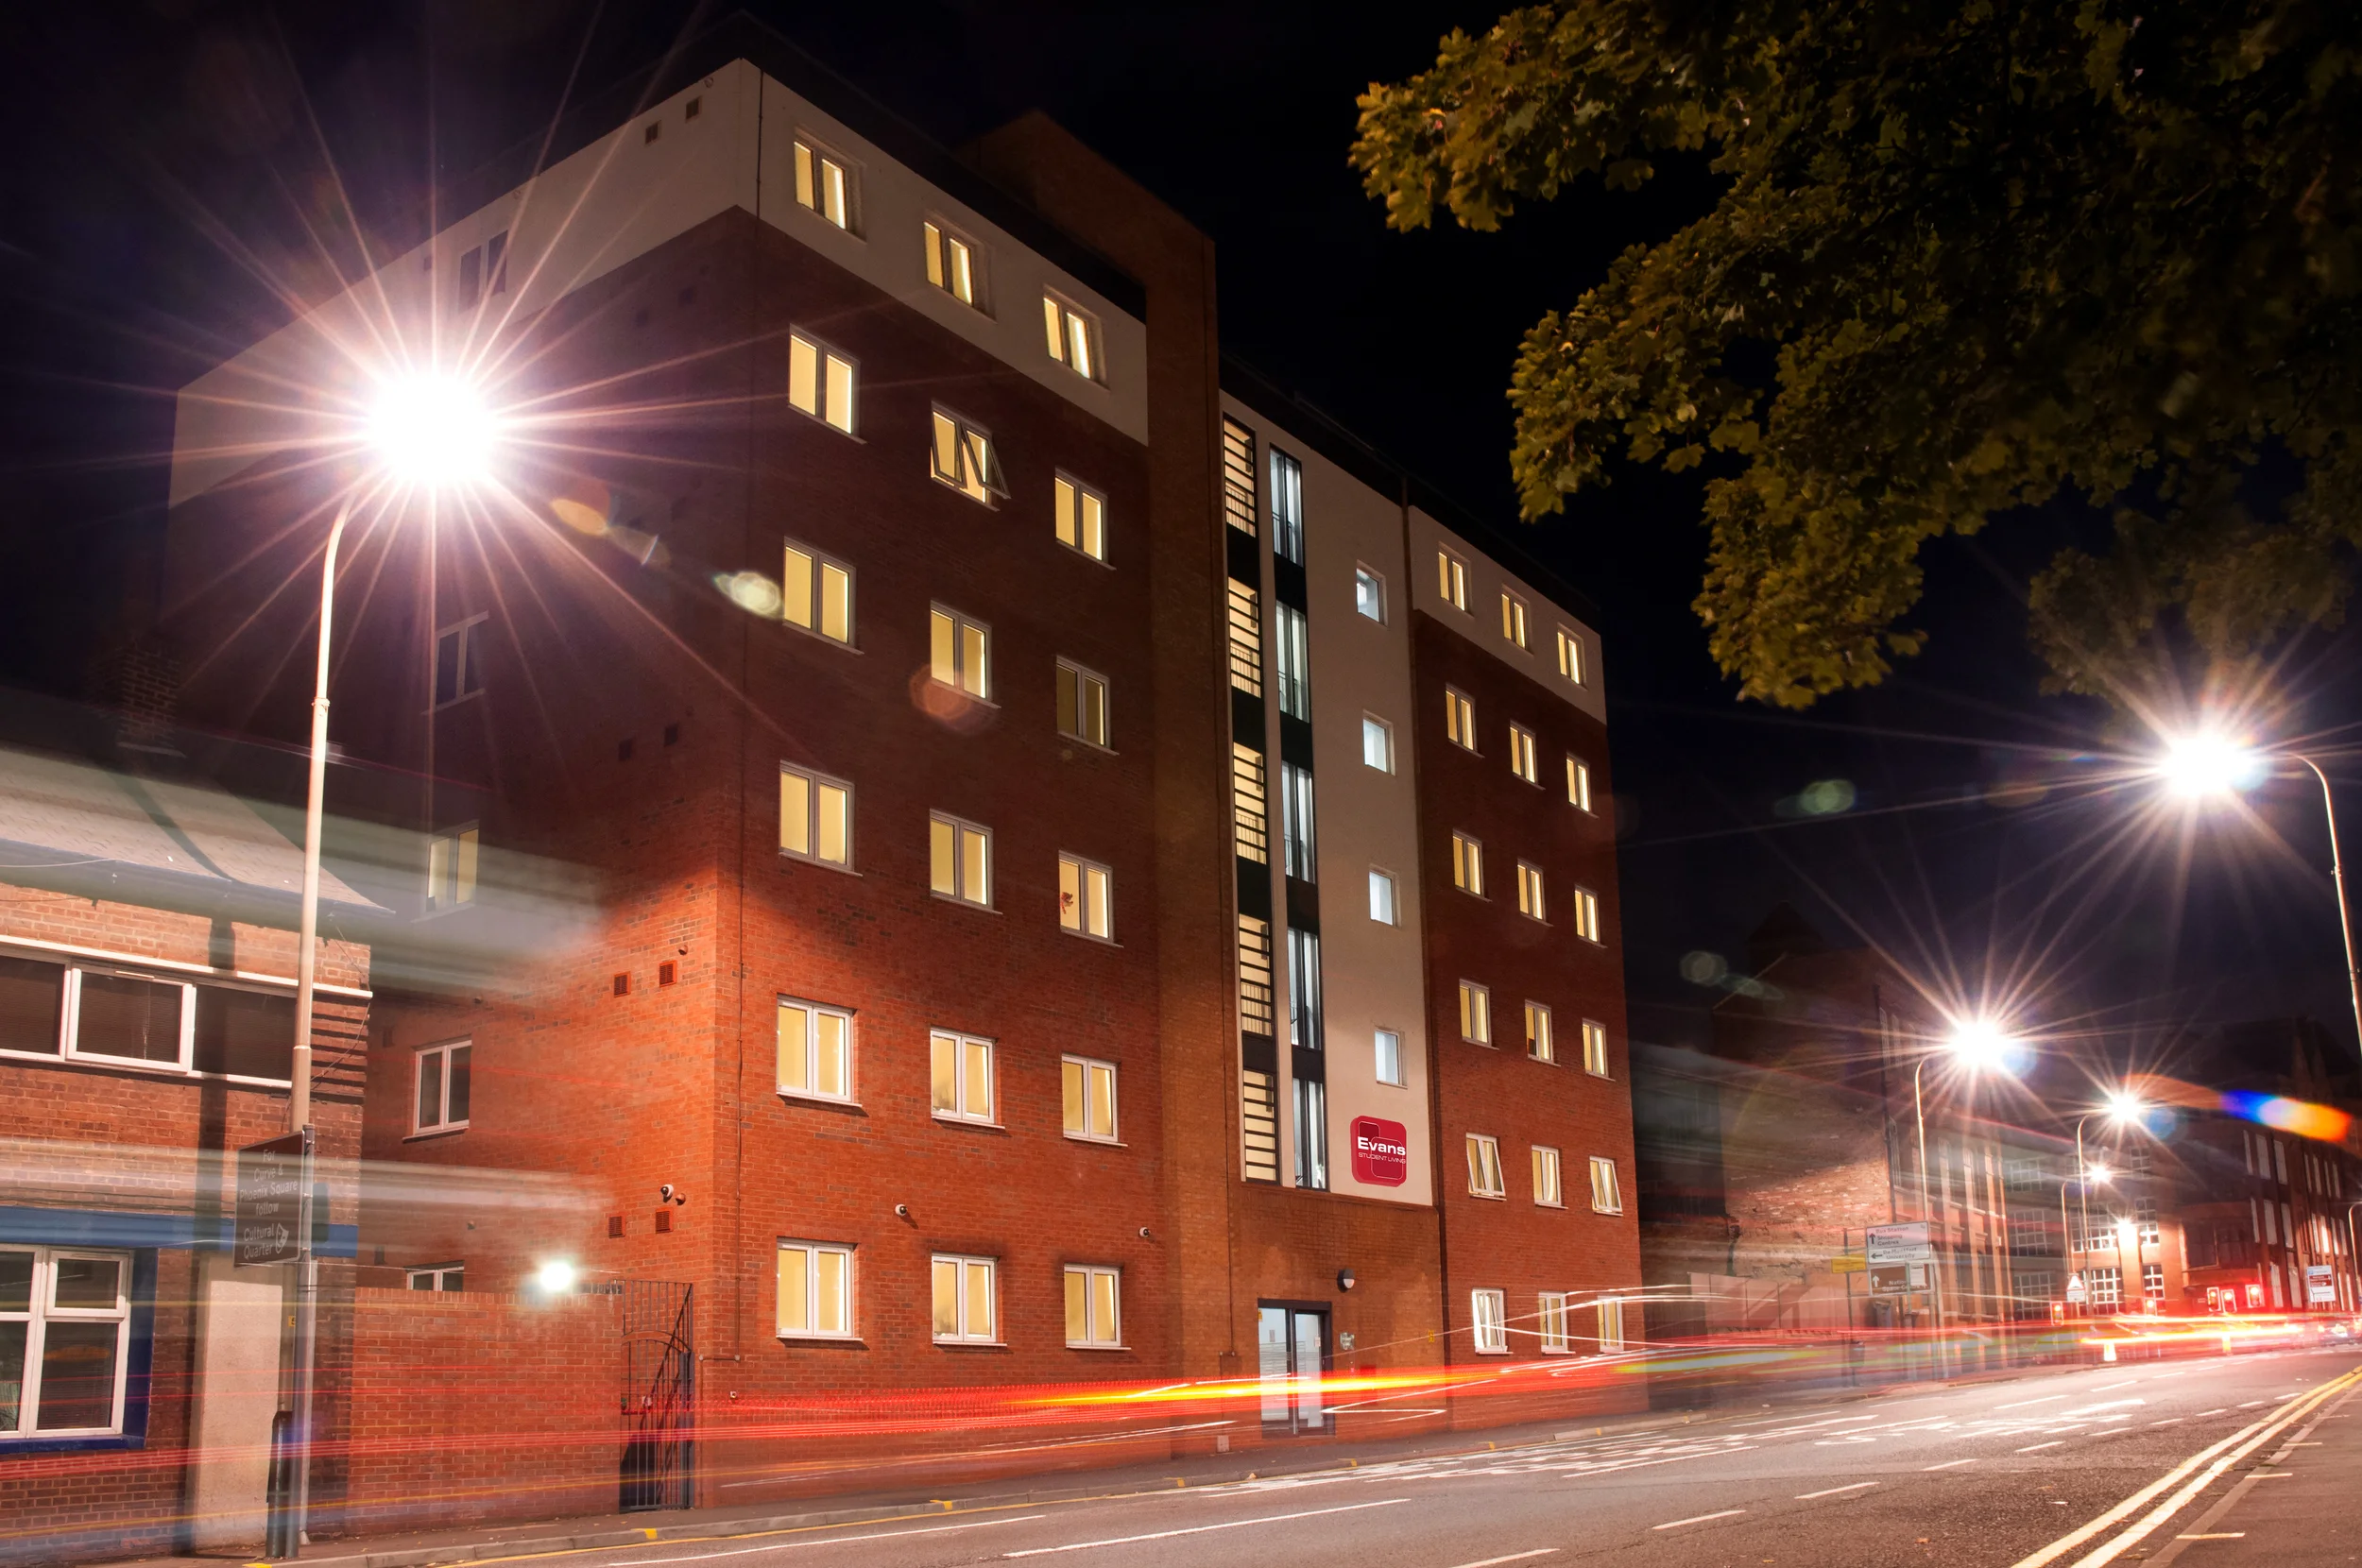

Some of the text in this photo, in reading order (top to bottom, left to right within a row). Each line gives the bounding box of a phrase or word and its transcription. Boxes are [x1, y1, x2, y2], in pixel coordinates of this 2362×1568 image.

[1358, 1136, 1406, 1155] Evans
[263, 1150, 275, 1162] For
[1359, 1152, 1387, 1161] STUDENT
[254, 1164, 283, 1182] Curve &
[239, 1181, 298, 1202] Phoenix Square
[256, 1202, 279, 1216] follow
[244, 1223, 275, 1241] Cultural
[244, 1243, 273, 1259] Quarter
